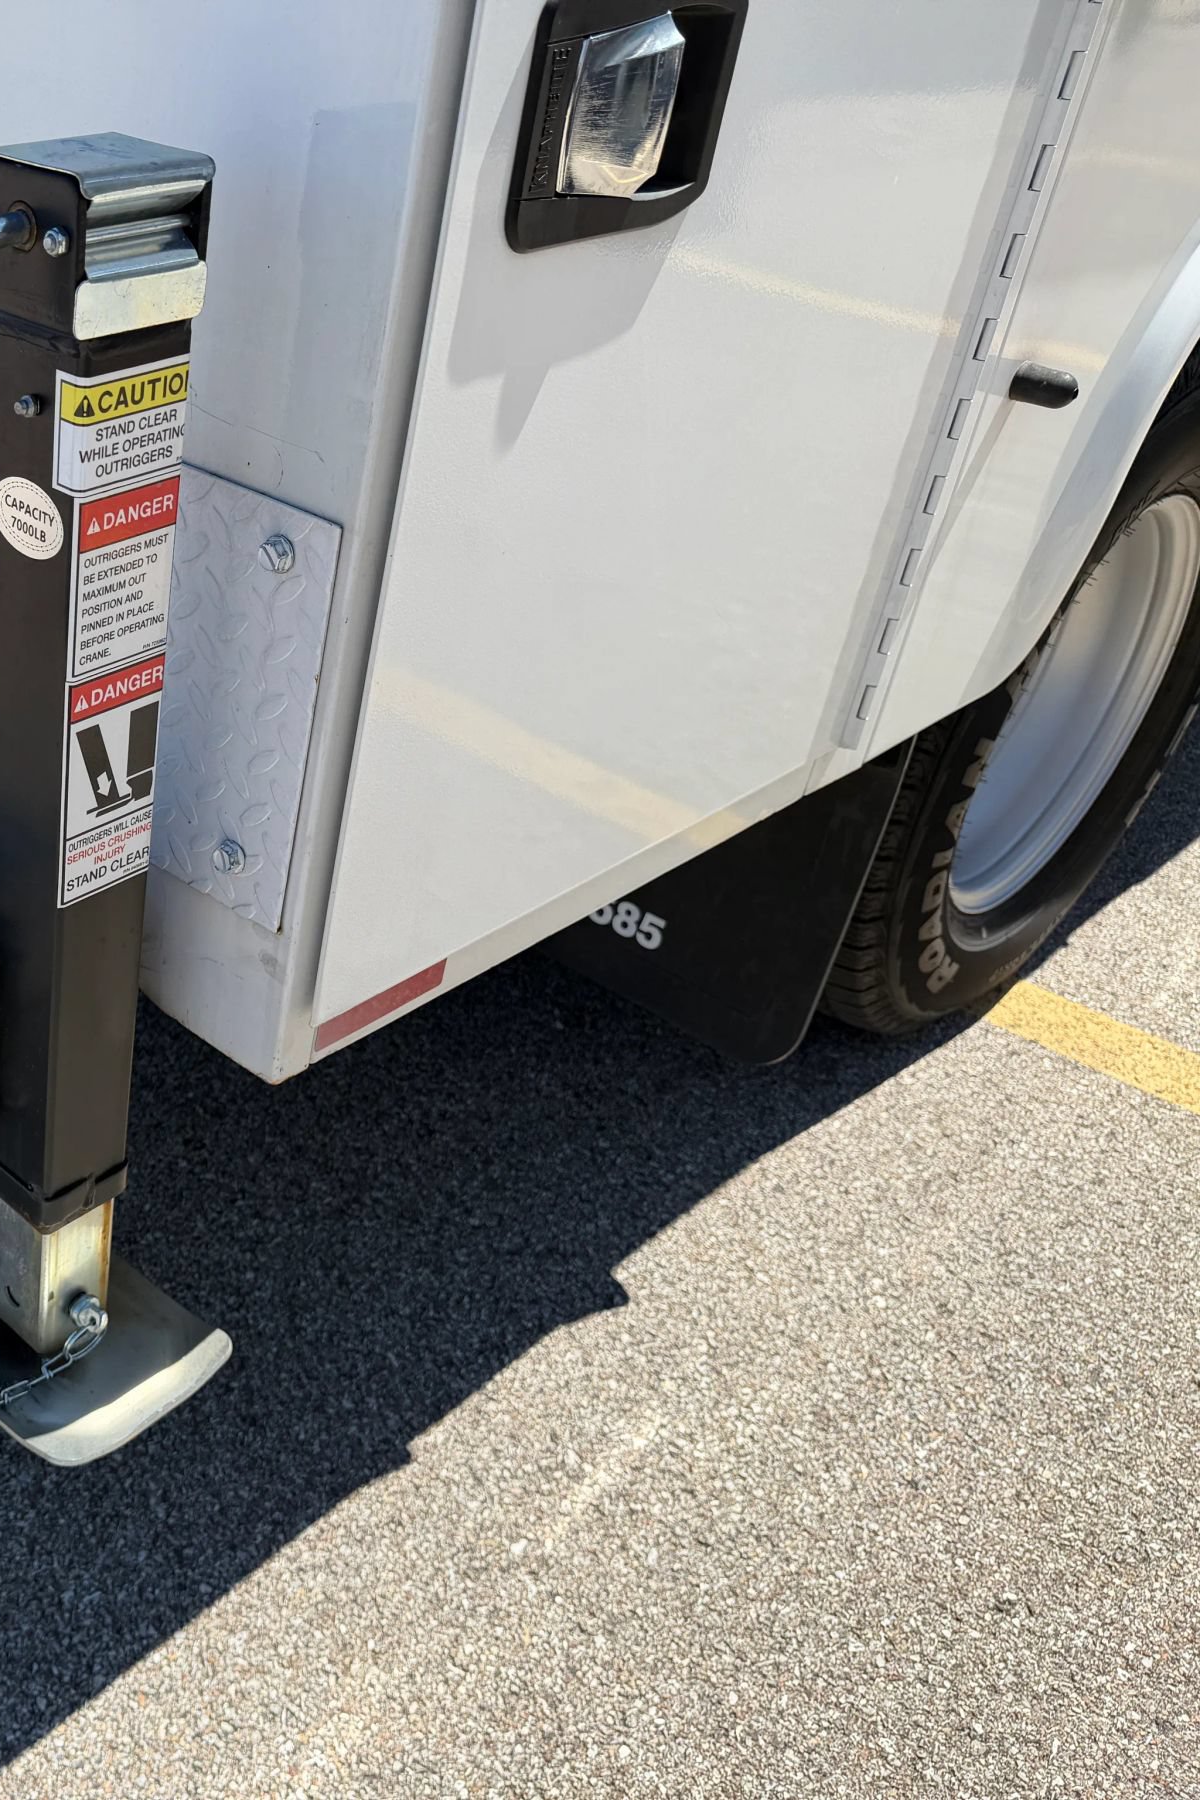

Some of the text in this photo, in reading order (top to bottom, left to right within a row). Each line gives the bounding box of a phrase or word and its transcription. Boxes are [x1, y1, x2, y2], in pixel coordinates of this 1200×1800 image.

[98, 369, 189, 414] CAUTIO
[95, 408, 177, 442] STAND CLEAR
[78, 442, 119, 464] WHILE
[95, 446, 173, 478] OUTRIGGERS
[4, 494, 55, 527] CAPACITY
[103, 493, 174, 529] DANGER
[11, 515, 46, 543] 7000LB
[84, 533, 169, 569] OUTRIGGERS MUST
[83, 553, 158, 586] BE EXTENDED TO
[81, 590, 143, 619] POSITION AND
[82, 573, 147, 603] MAXIMUM OUT
[80, 601, 155, 635] PINNED IN PLACE
[80, 613, 165, 651] BEFORE OPERATING
[79, 647, 112, 666] CRANE.
[90, 665, 164, 706] DANGER
[66, 821, 152, 866] SERIOUS CRUSHING
[68, 809, 153, 852] OUTRIGGERS WILL CAUSE
[66, 867, 107, 893] STAND
[110, 846, 149, 872] CLEAR
[93, 844, 126, 865] INJURY
